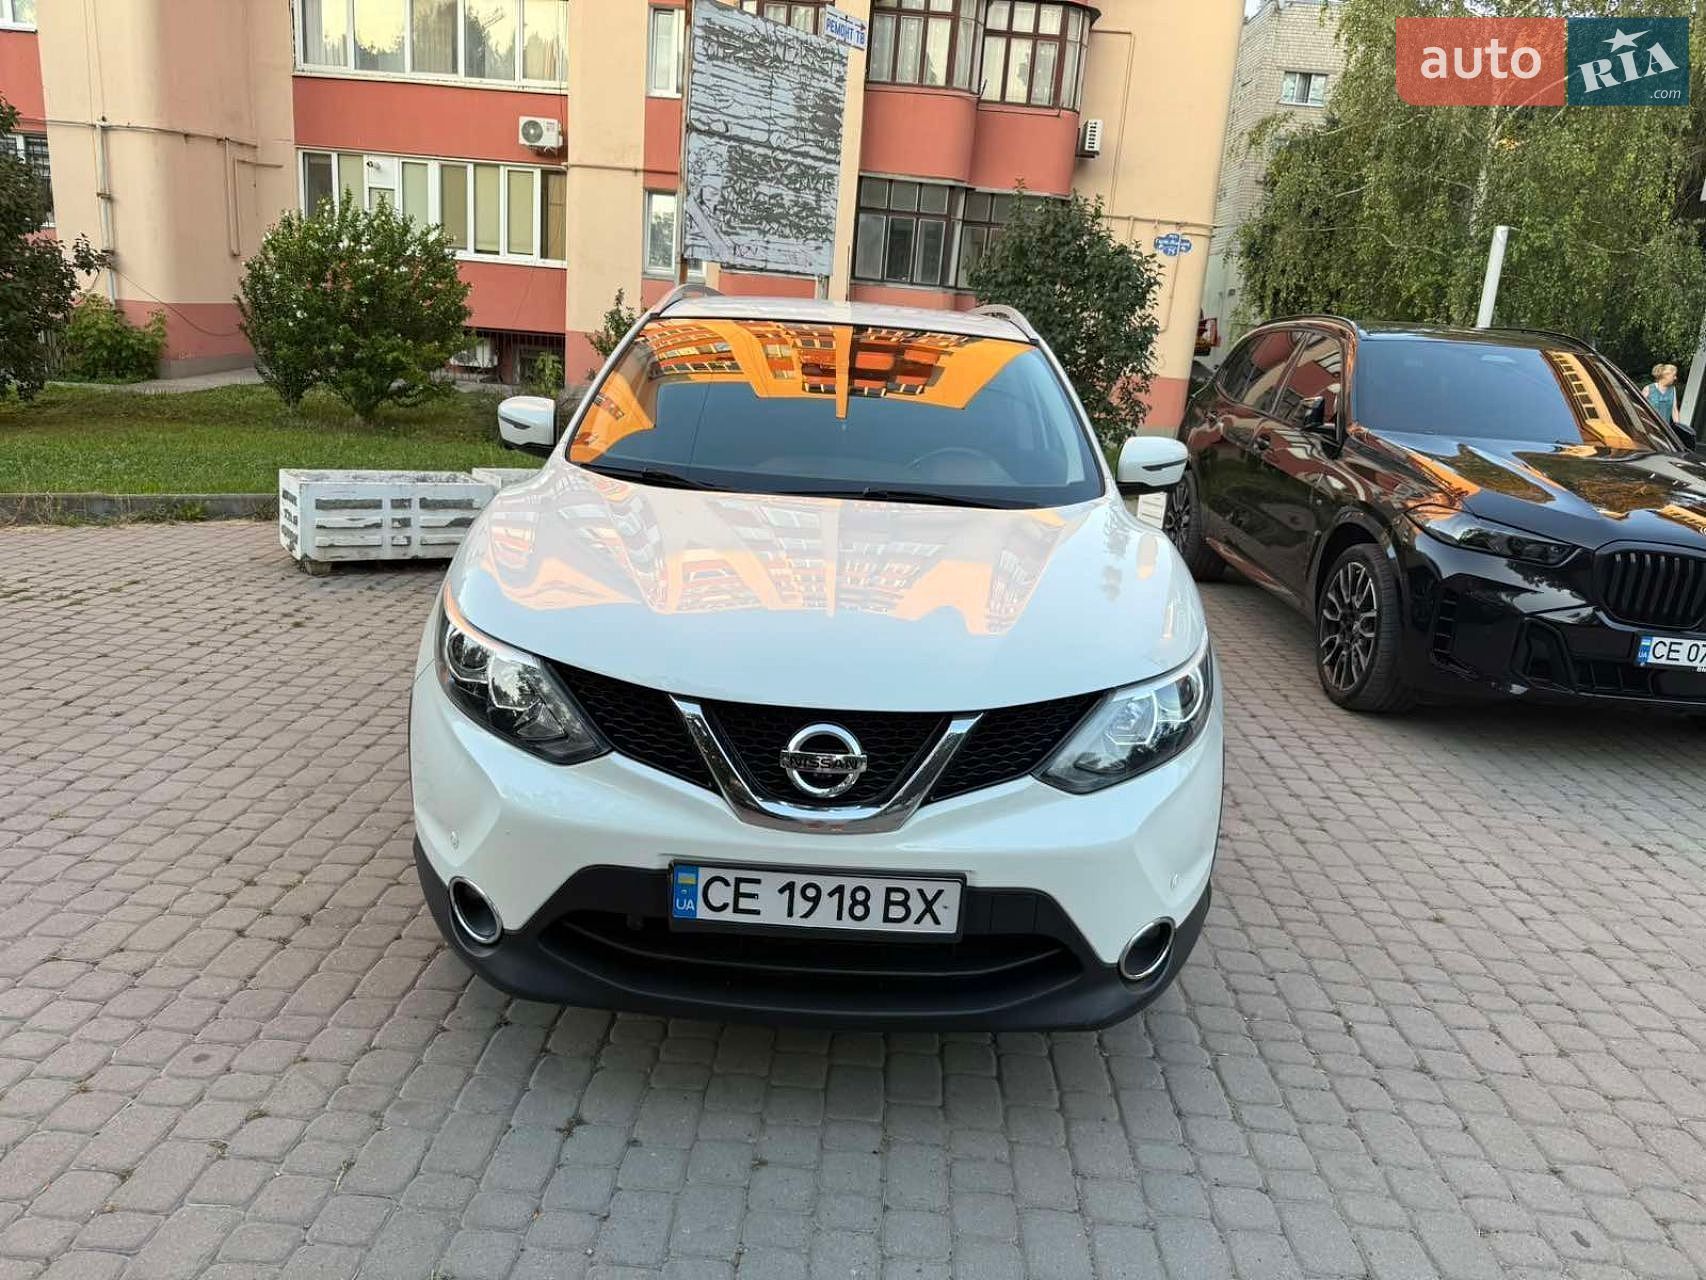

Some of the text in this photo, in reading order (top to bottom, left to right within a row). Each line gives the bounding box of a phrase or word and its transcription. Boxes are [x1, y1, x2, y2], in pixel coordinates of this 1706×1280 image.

[826, 17, 865, 45] РЕМОНТ ТВ
[1652, 640, 1683, 662] CE
[789, 756, 858, 770] NISSAN
[675, 898, 695, 912] UA
[702, 875, 945, 926] CE 1918 BX
